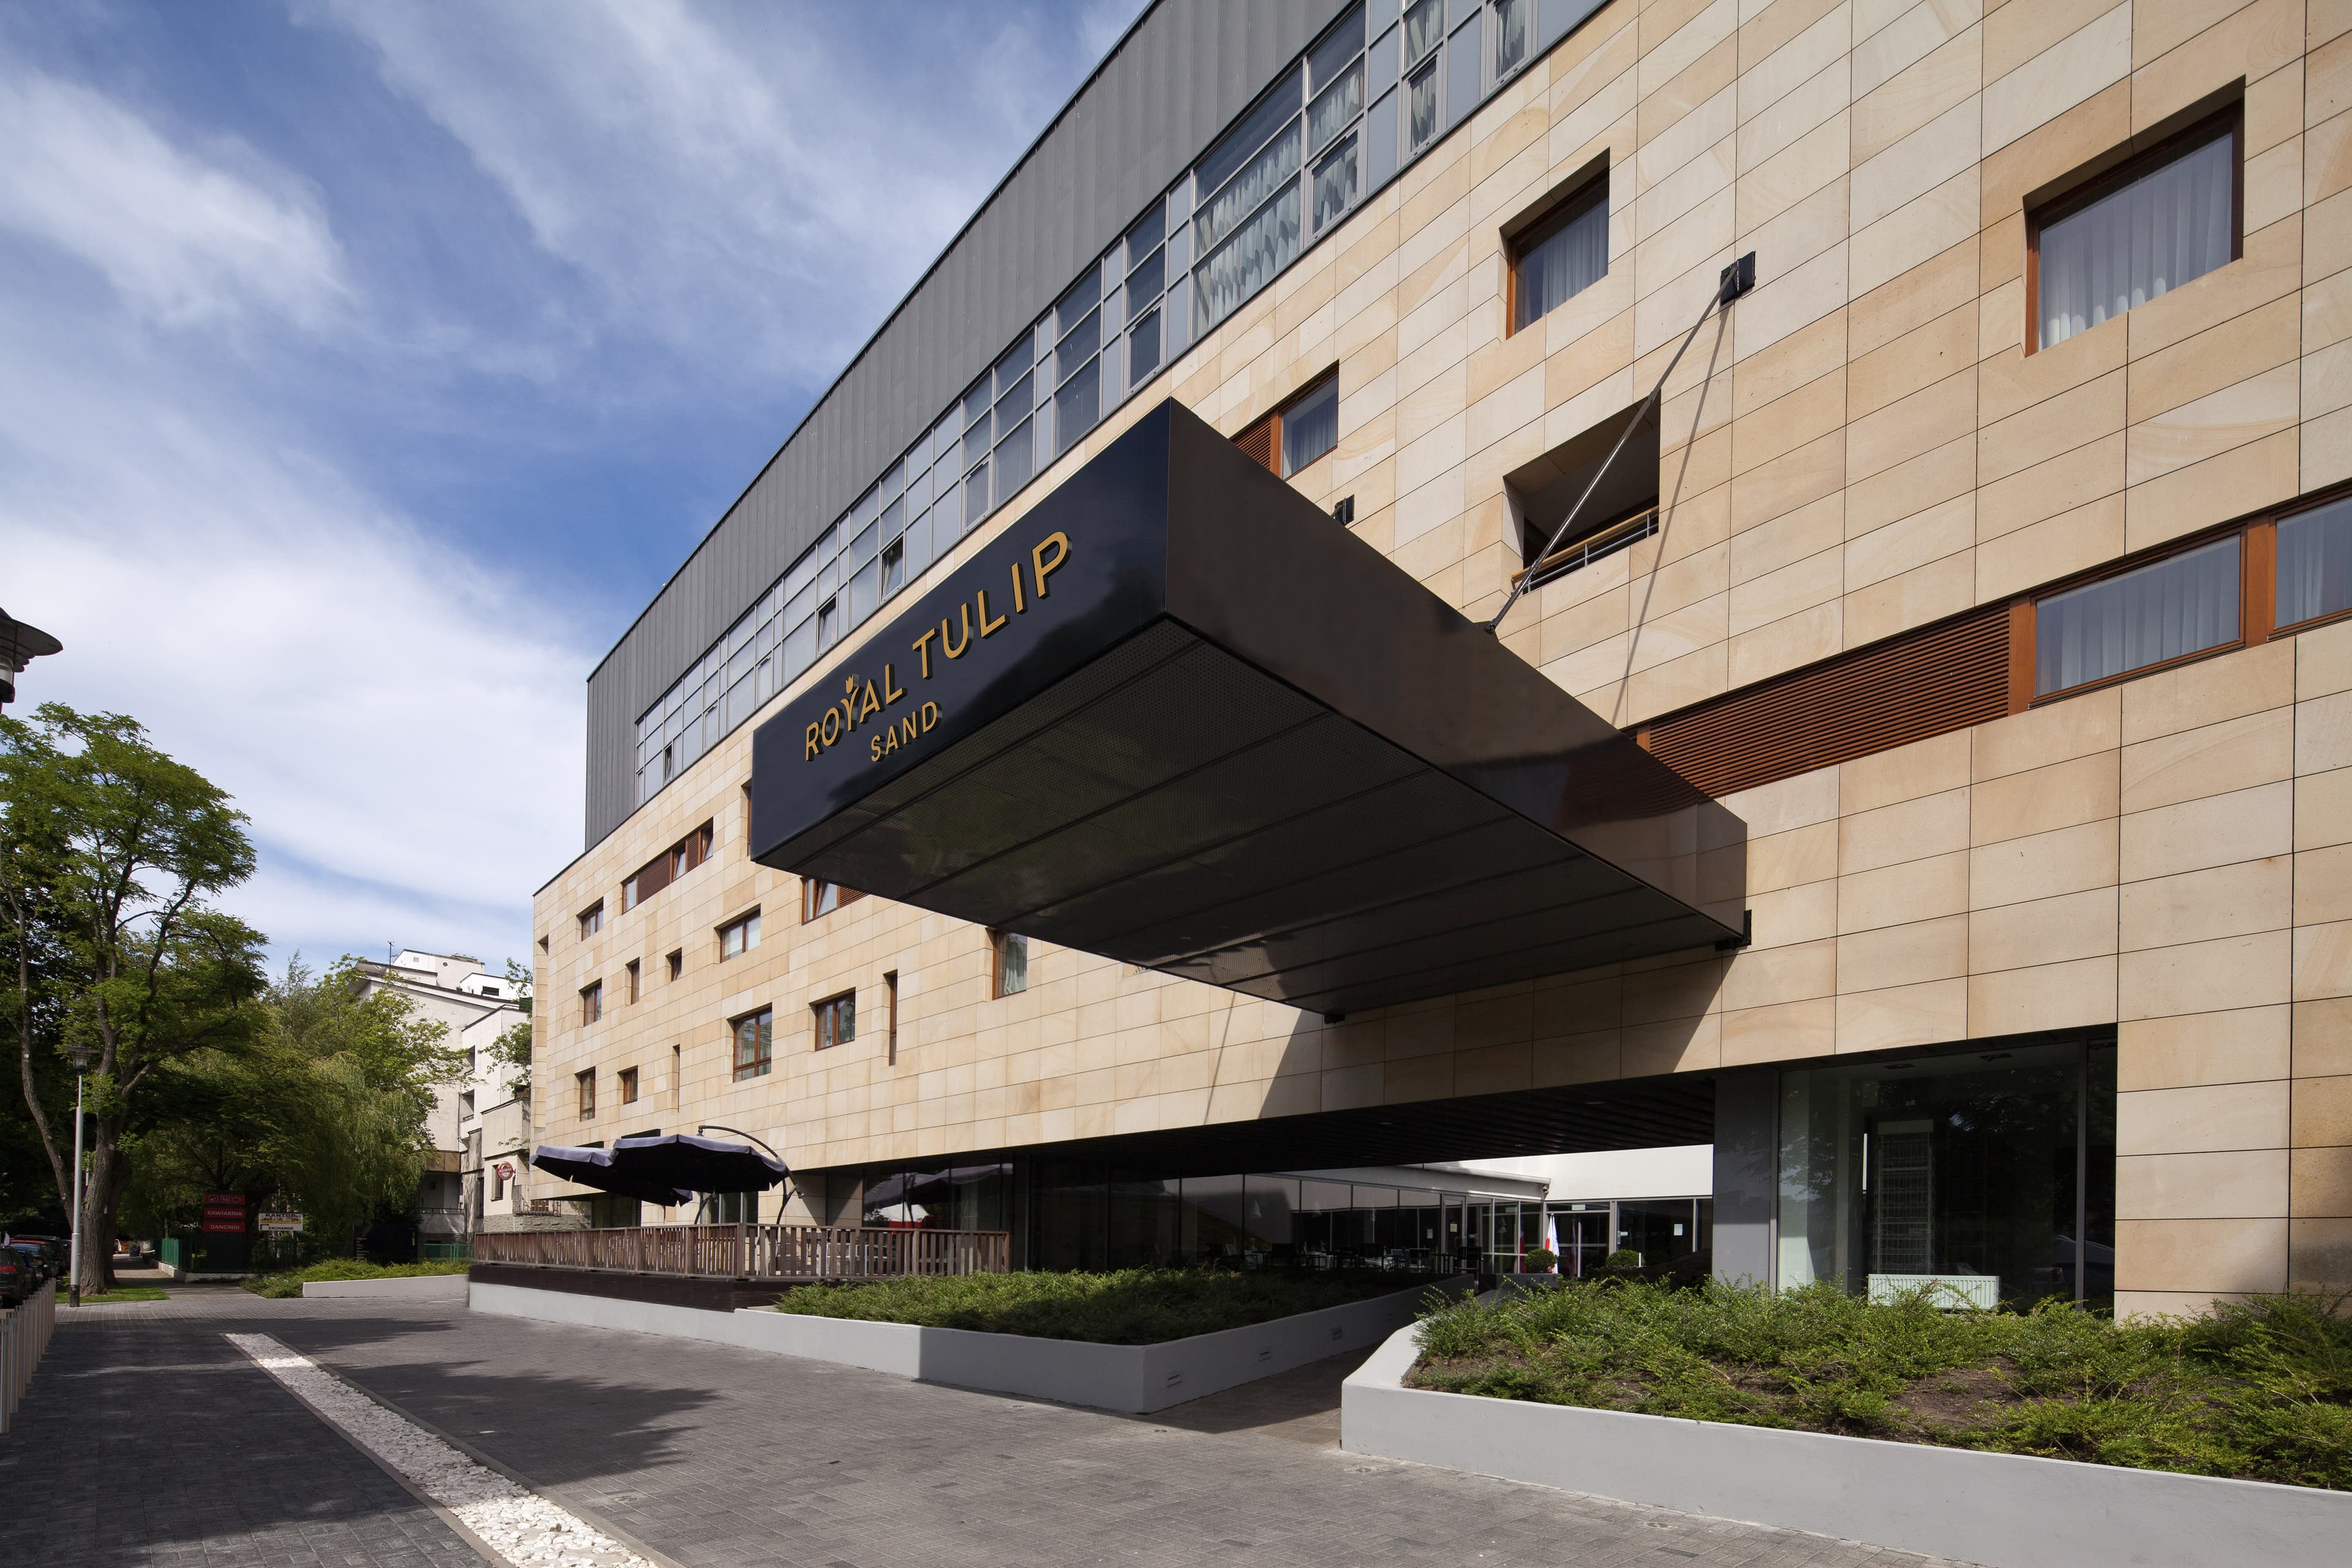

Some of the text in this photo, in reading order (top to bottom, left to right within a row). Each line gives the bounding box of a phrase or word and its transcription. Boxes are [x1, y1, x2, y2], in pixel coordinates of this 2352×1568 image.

[805, 531, 1071, 761] ROYAL TULIP
[870, 701, 941, 762] SAND
